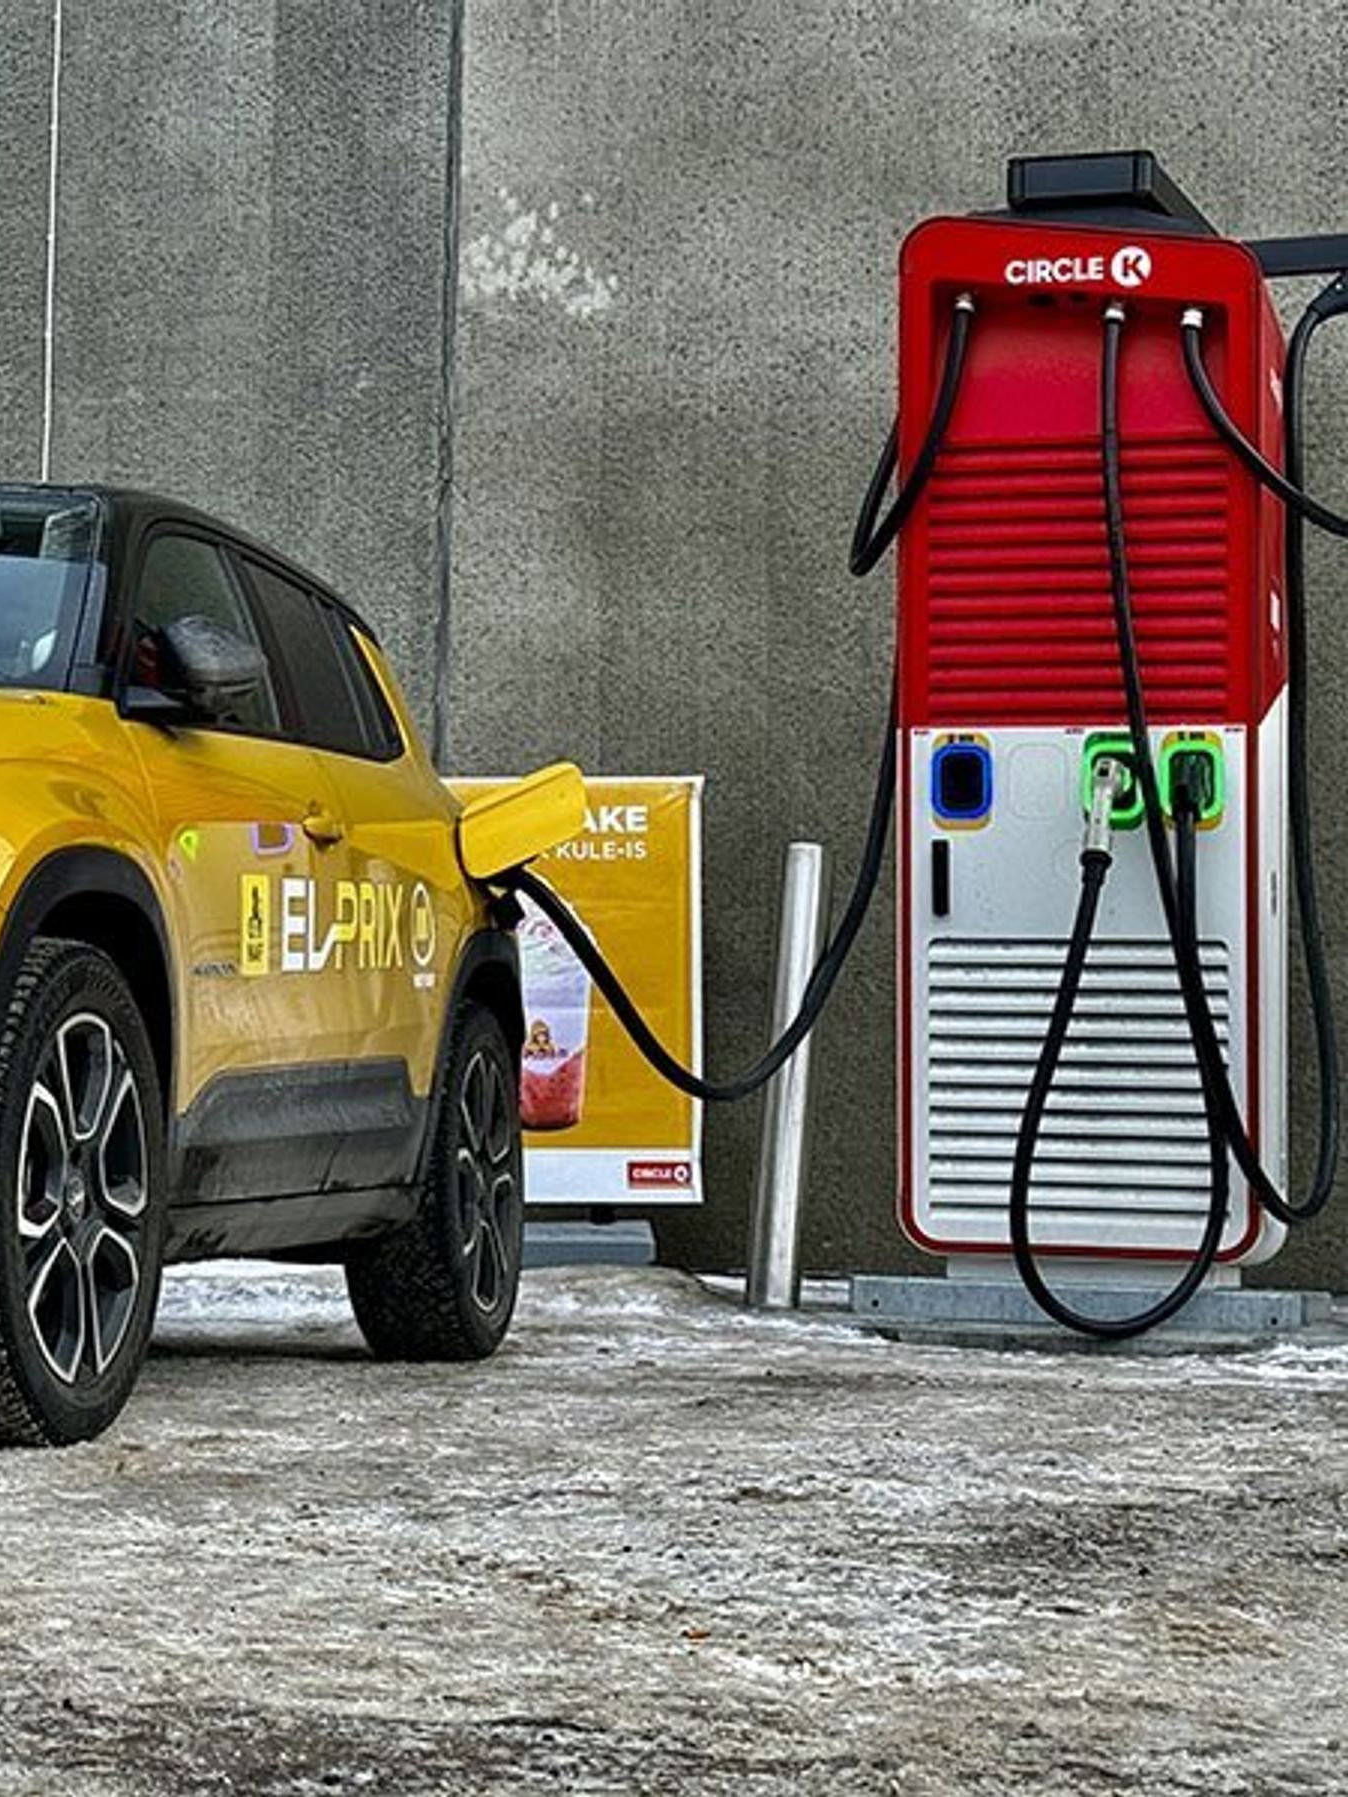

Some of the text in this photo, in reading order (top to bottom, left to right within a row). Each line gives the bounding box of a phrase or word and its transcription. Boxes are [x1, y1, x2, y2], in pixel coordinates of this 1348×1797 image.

[1004, 251, 1150, 285] CIRCLE K
[583, 805, 648, 833] AKE
[556, 840, 648, 860] KULE-IS
